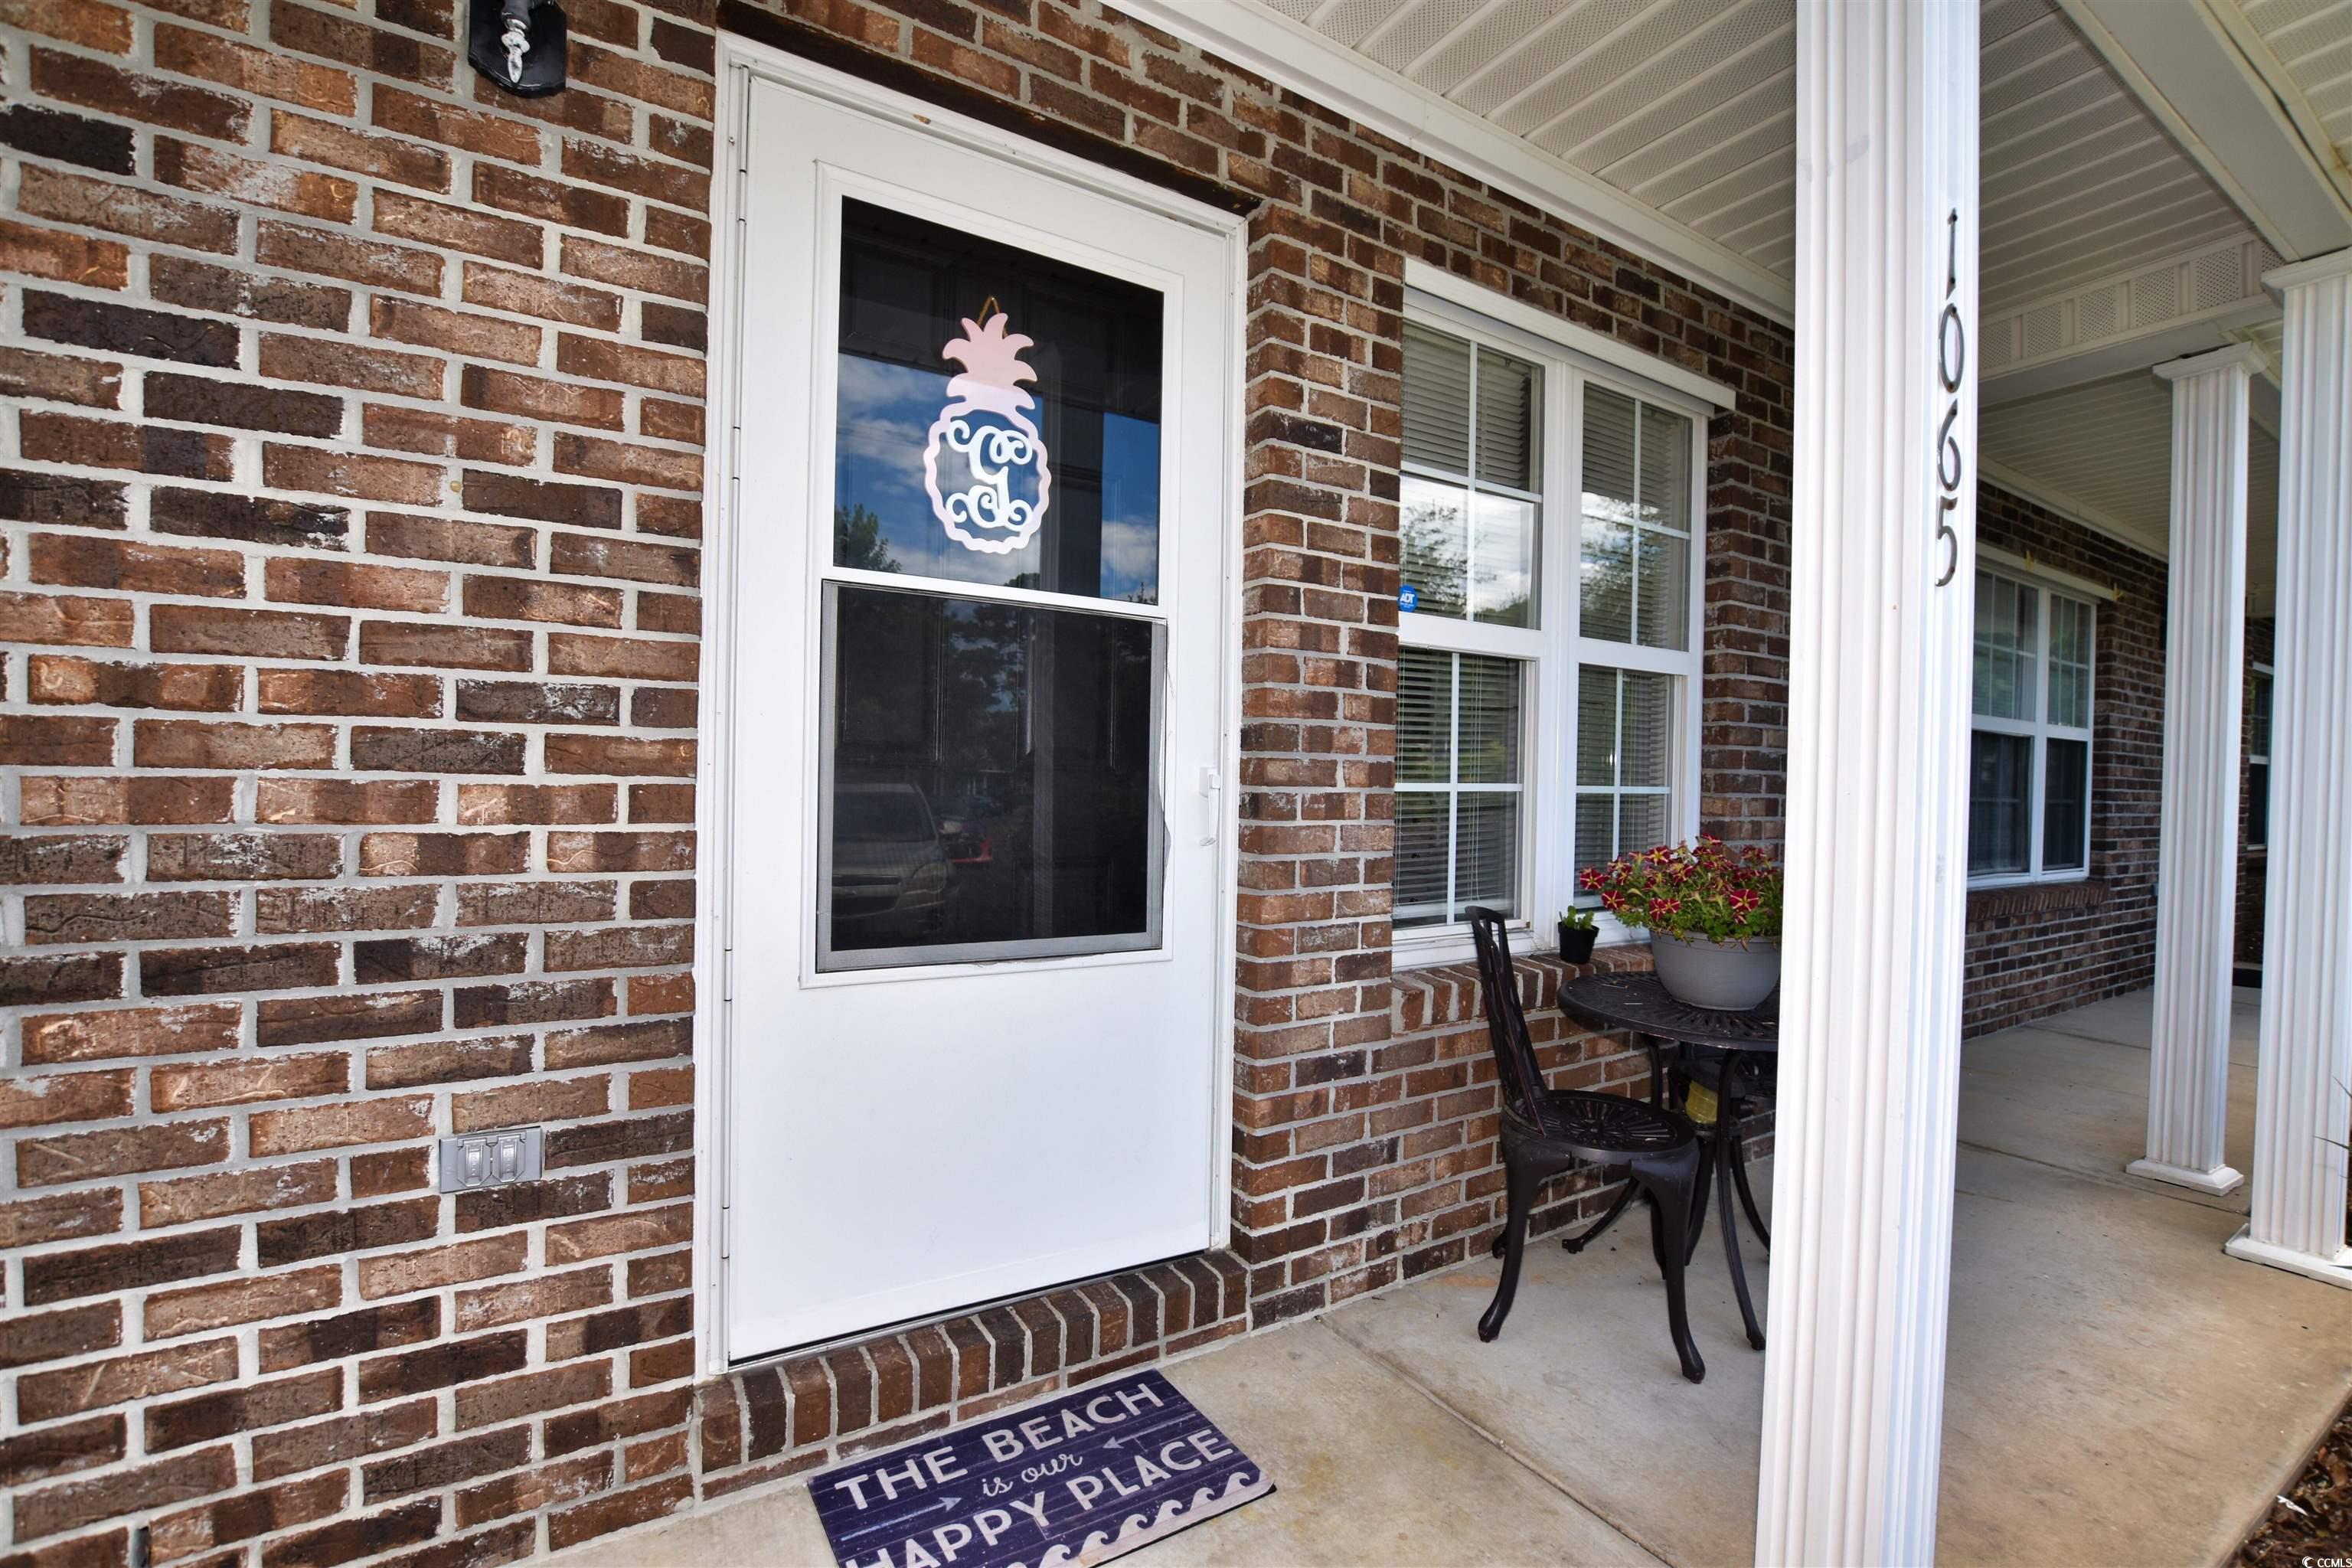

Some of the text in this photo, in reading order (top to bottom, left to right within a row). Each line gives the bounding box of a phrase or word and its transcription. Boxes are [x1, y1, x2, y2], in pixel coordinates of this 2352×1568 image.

[1935, 207, 1965, 587] 1065
[1400, 593, 1415, 603] ADT
[835, 1383, 1164, 1510] THE BEACH
[982, 1452, 1083, 1497] is our
[1067, 1429, 1233, 1511] PLACE
